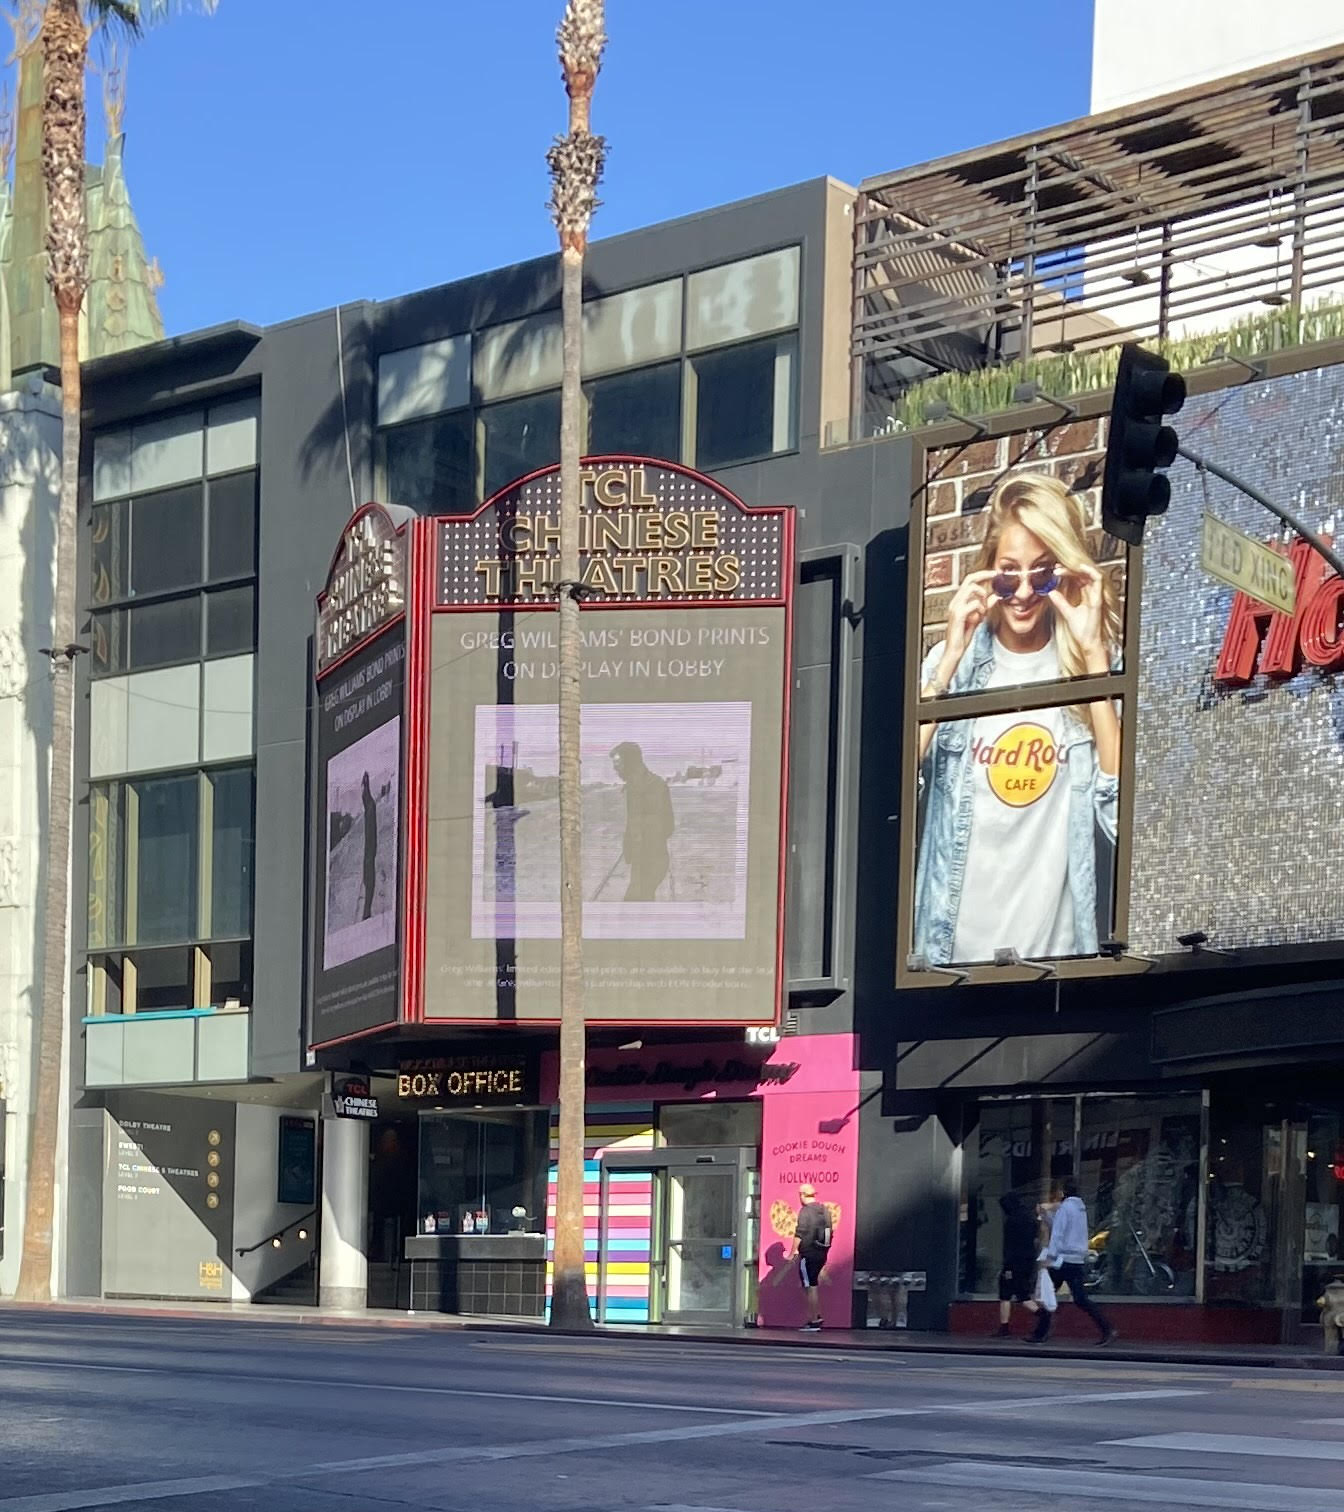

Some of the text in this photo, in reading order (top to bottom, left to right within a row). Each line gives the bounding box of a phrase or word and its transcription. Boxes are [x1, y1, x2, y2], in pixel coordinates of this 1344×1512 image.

[579, 468, 657, 509] TCL
[501, 511, 720, 553] CHINESE
[1207, 525, 1289, 601] PED XING
[460, 626, 771, 650] GREG WILAMS' BOND PRINTS
[502, 658, 726, 680] ON DPLAY IN LOBBY
[970, 736, 1024, 766] Hard
[1004, 778, 1037, 791] CAFE
[746, 1026, 781, 1042] TCL
[398, 1069, 522, 1097] BOX OFFICE
[344, 1096, 377, 1109] CHINESE
[345, 1106, 378, 1117] THEATRES
[119, 1120, 141, 1129] DOLBY
[143, 1122, 171, 1132] THEATRE
[772, 1140, 846, 1156] COOKIE DOUGH
[789, 1153, 828, 1164] DREAMS
[779, 1171, 840, 1184] HOLLYWOOD
